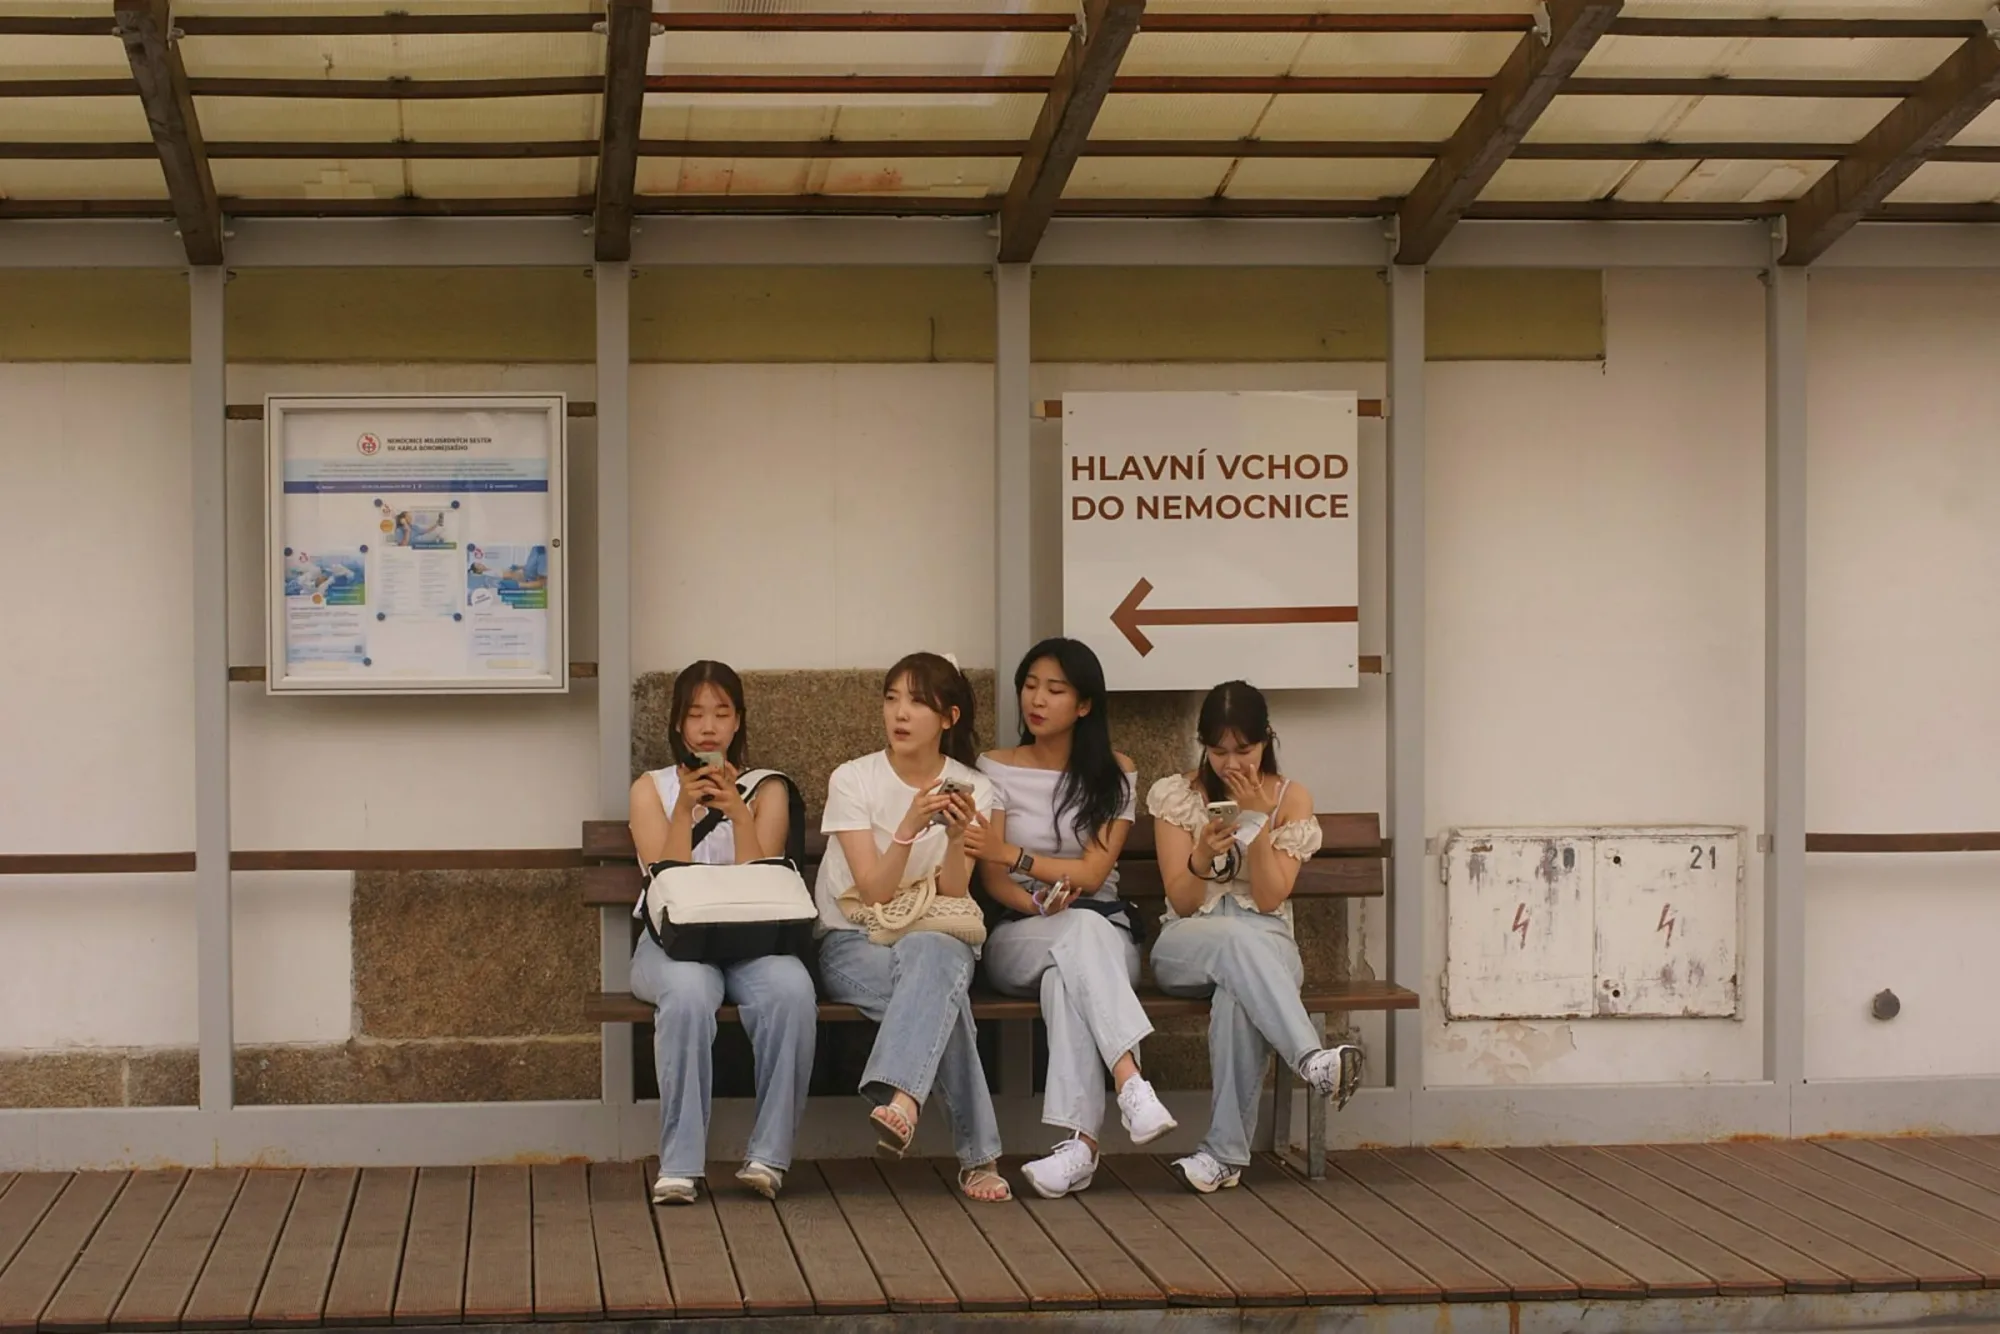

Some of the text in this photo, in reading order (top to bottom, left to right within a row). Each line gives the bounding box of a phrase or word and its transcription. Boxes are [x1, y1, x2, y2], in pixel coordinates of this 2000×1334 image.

[1071, 448, 1349, 481] HLAVNÍ VCHOD
[1071, 493, 1349, 520] DO NEMOCNICE
[1689, 845, 1717, 870] 21
